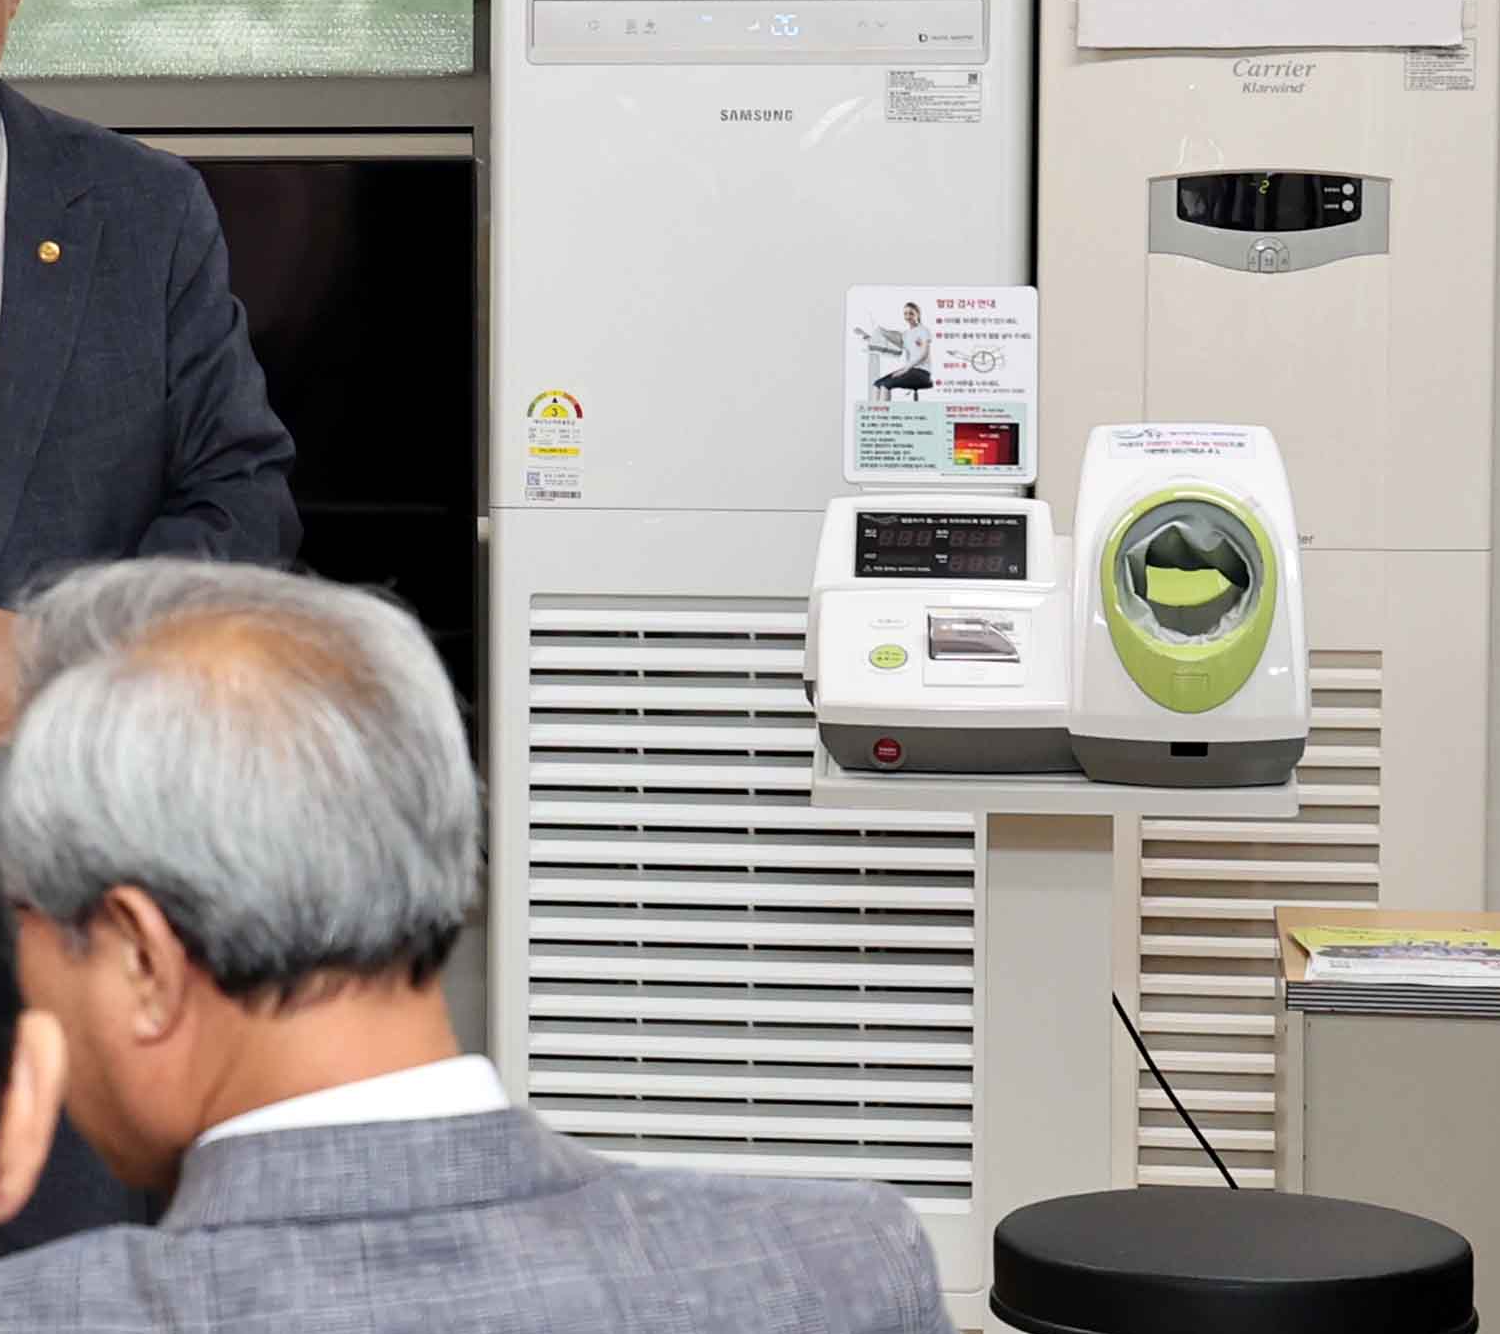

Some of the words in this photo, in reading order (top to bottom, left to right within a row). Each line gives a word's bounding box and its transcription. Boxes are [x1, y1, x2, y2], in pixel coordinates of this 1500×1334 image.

[1233, 59, 1316, 78] Carrier
[1242, 81, 1304, 94] Klarwind
[719, 109, 793, 122] SAMSUNG
